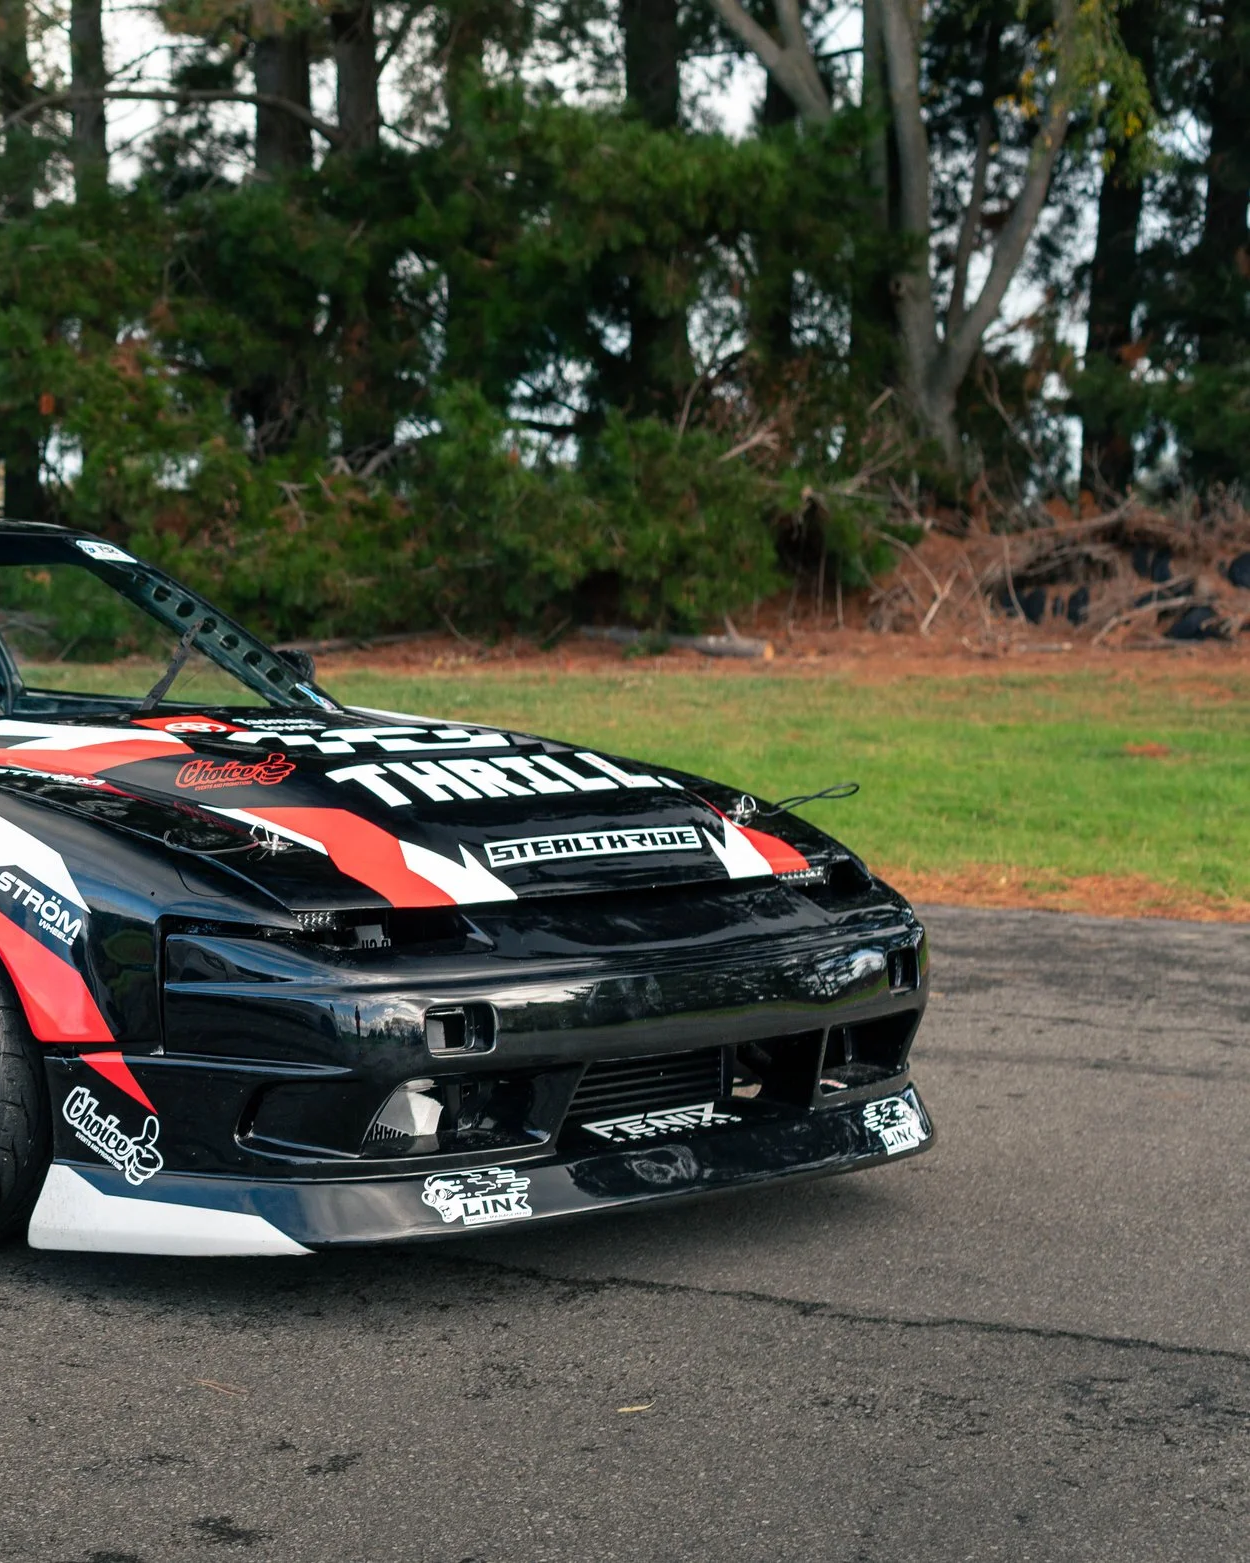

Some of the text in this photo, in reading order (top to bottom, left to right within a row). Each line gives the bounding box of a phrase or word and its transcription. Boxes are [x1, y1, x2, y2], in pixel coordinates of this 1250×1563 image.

[175, 759, 261, 789] Choice
[490, 830, 698, 862] STEALTHRIDE
[38, 918, 75, 946] WHEELS
[62, 1086, 134, 1161] Choice
[581, 1101, 733, 1140] FENIX
[882, 1127, 915, 1147] LINK
[462, 1195, 528, 1217] LINK
